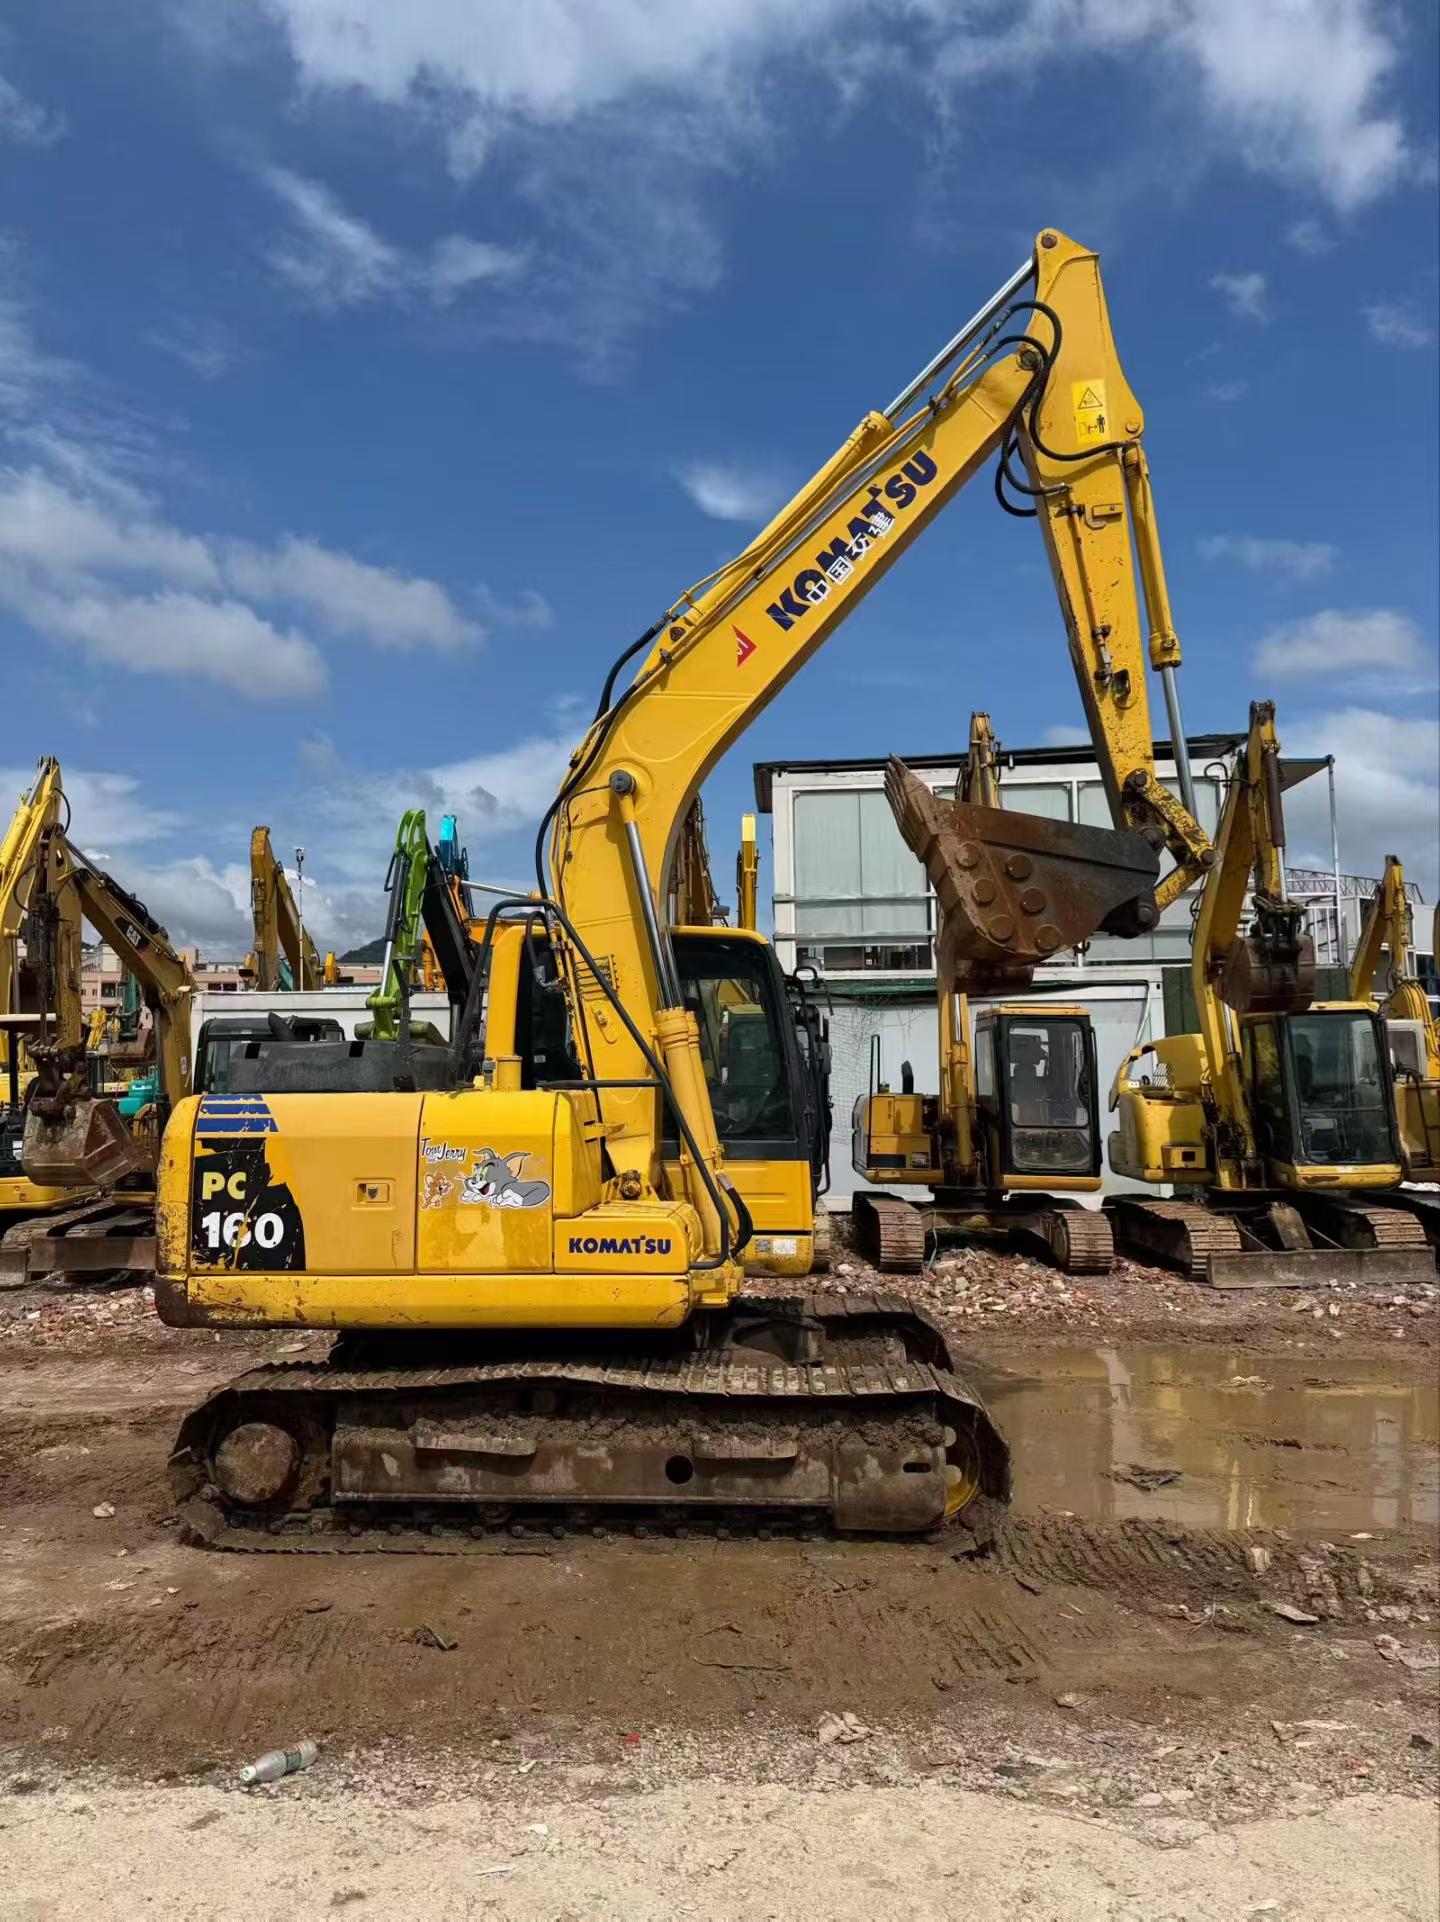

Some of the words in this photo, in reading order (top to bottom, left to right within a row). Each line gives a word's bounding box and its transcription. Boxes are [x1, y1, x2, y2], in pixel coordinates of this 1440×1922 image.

[766, 450, 938, 632] KOMATSU
[126, 924, 142, 947] CAT
[421, 1137, 442, 1157] Tom
[437, 1142, 467, 1162] Jerry
[202, 1171, 247, 1200] PC
[201, 1211, 285, 1249] 160
[568, 1234, 672, 1255] KOMATSU
